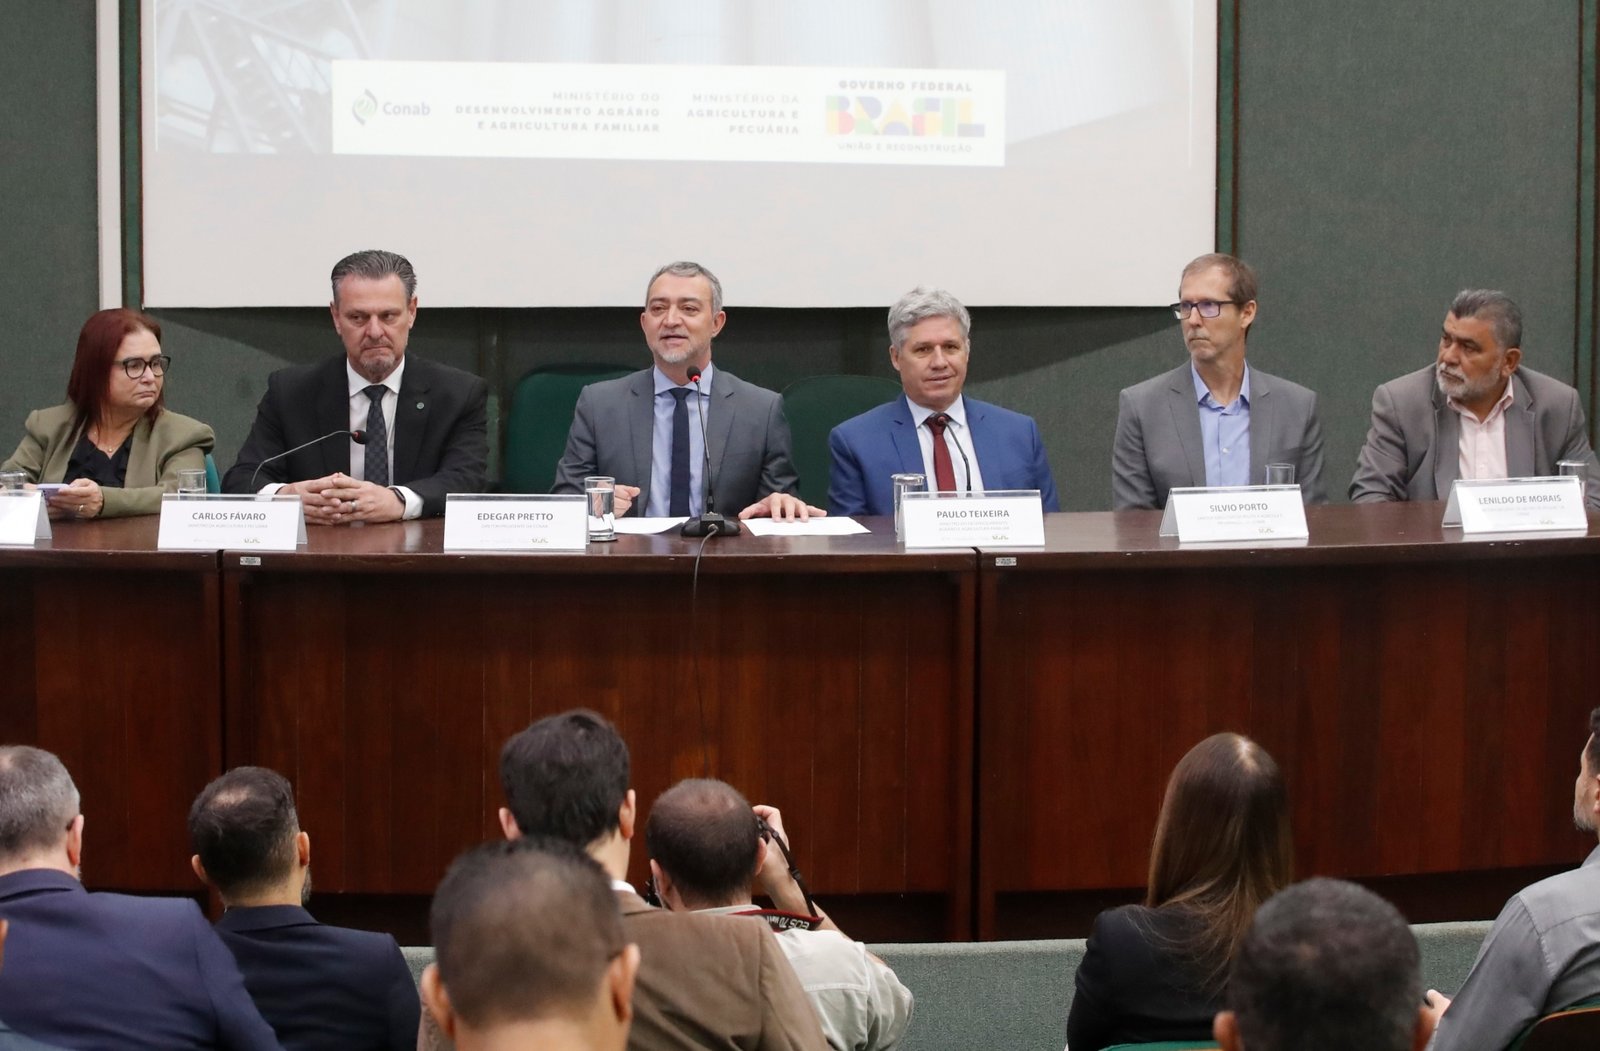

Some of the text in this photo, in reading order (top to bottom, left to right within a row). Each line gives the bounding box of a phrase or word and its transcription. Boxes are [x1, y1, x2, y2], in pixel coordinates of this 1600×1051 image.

[838, 80, 973, 92] GOVERNO FEDERAL
[640, 92, 660, 102] DO
[781, 95, 799, 104] DA
[382, 101, 431, 117] Conab
[455, 105, 661, 118] DESENVOLVIMENTO AGRÁRIO
[687, 109, 799, 119] AGRICULTURA E
[825, 95, 985, 138] BRASIL
[477, 121, 661, 133] E AGRICULTURA FAMILIAR
[728, 123, 799, 135] PECUÁRIA
[875, 143, 882, 151] E
[1478, 494, 1562, 505] LENILDO DE MORAIS
[1209, 502, 1268, 513] SILVIO PORTO
[191, 511, 266, 521] CARLOS FÁVARO
[477, 512, 554, 521] EDEGAR PRETTO
[936, 509, 1010, 519] PAULO TEIXEIRA
[788, 918, 810, 930] EOS
